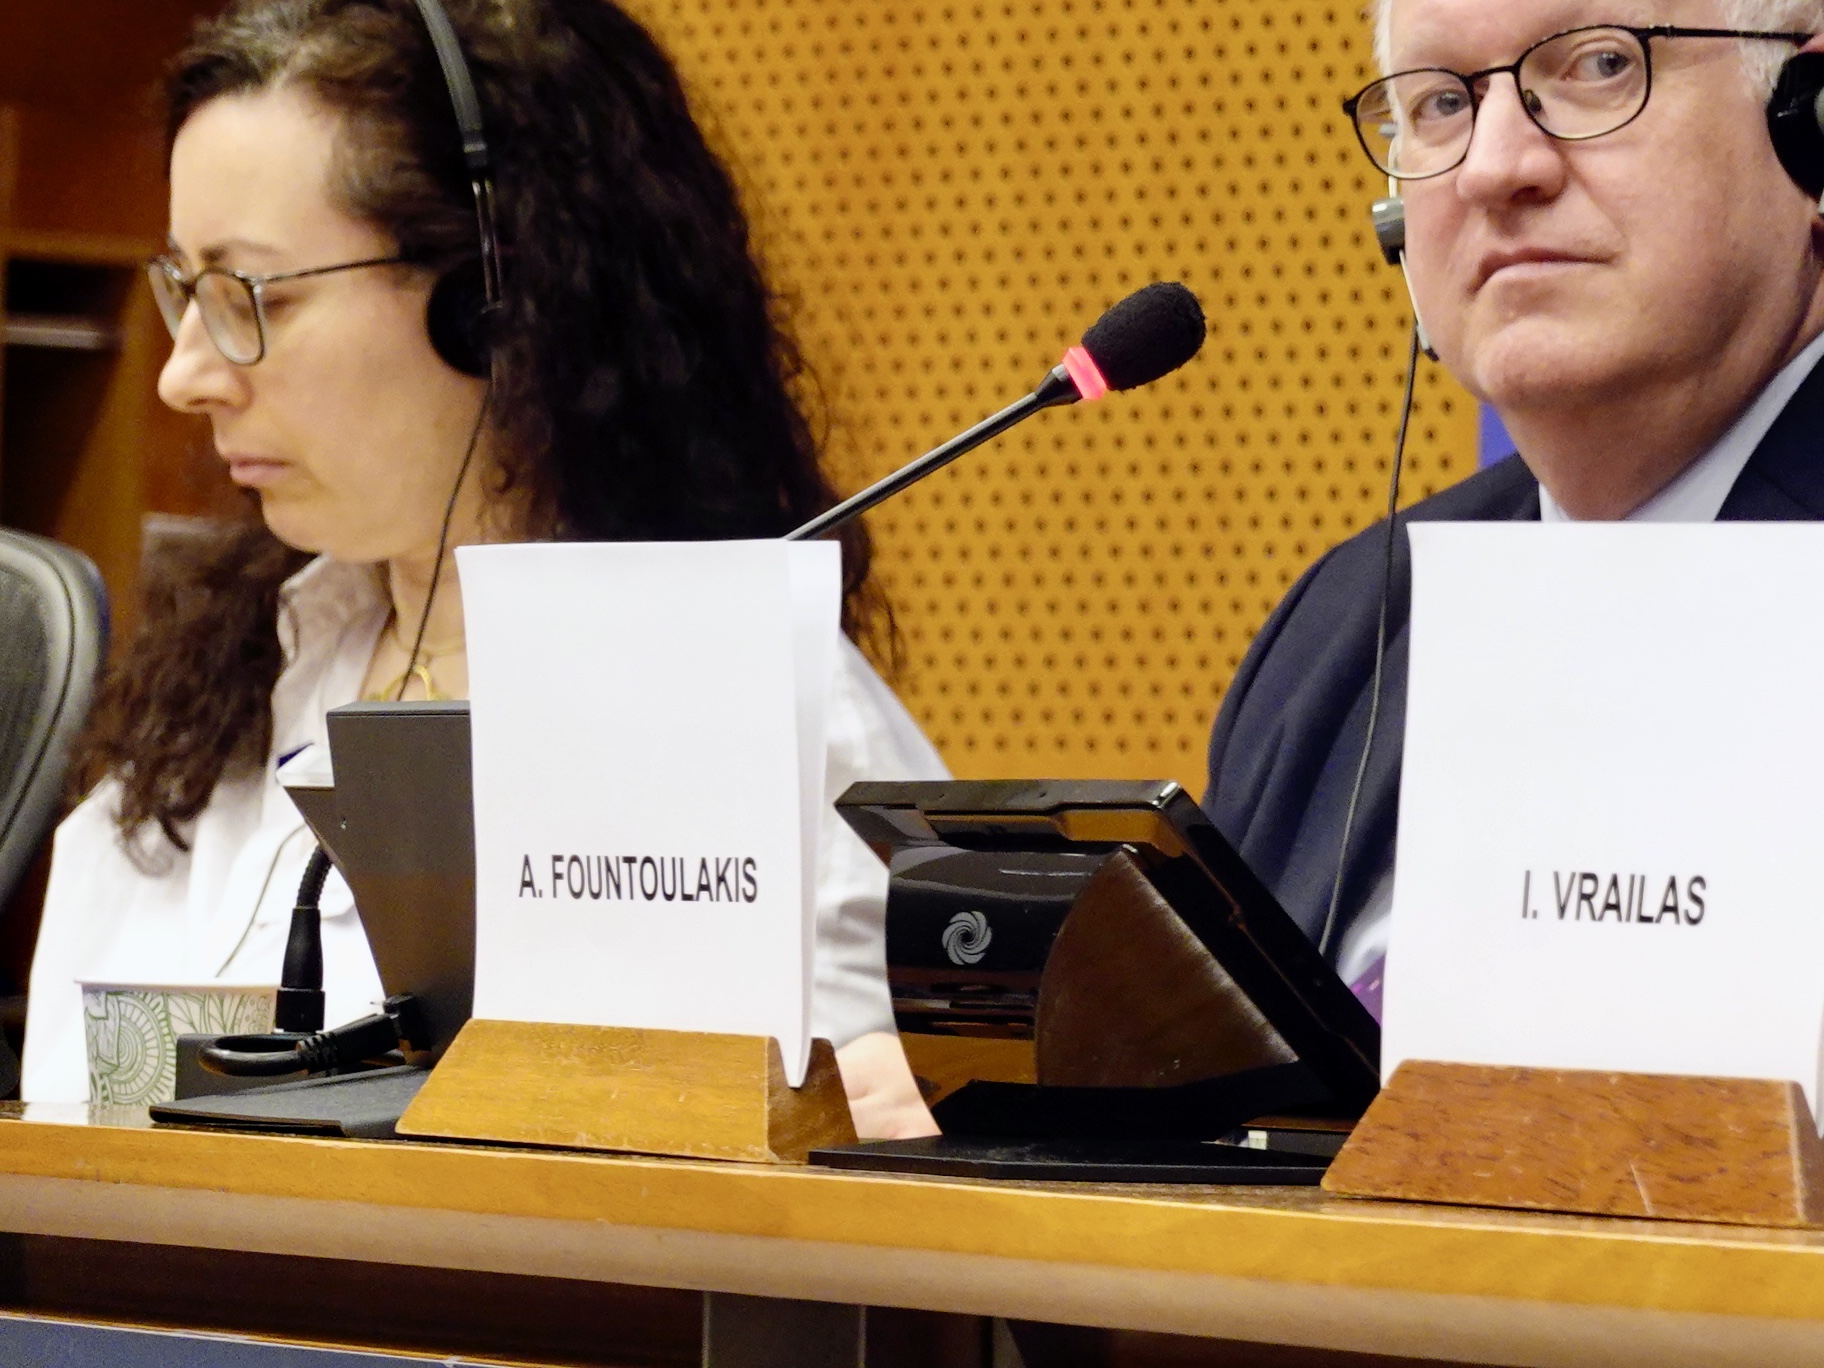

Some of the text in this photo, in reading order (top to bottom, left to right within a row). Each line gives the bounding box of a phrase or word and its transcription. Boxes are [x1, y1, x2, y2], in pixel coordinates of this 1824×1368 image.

[518, 854, 758, 904] A. FOUNTOULAKIS
[1521, 869, 1707, 926] I. VRAILAS
